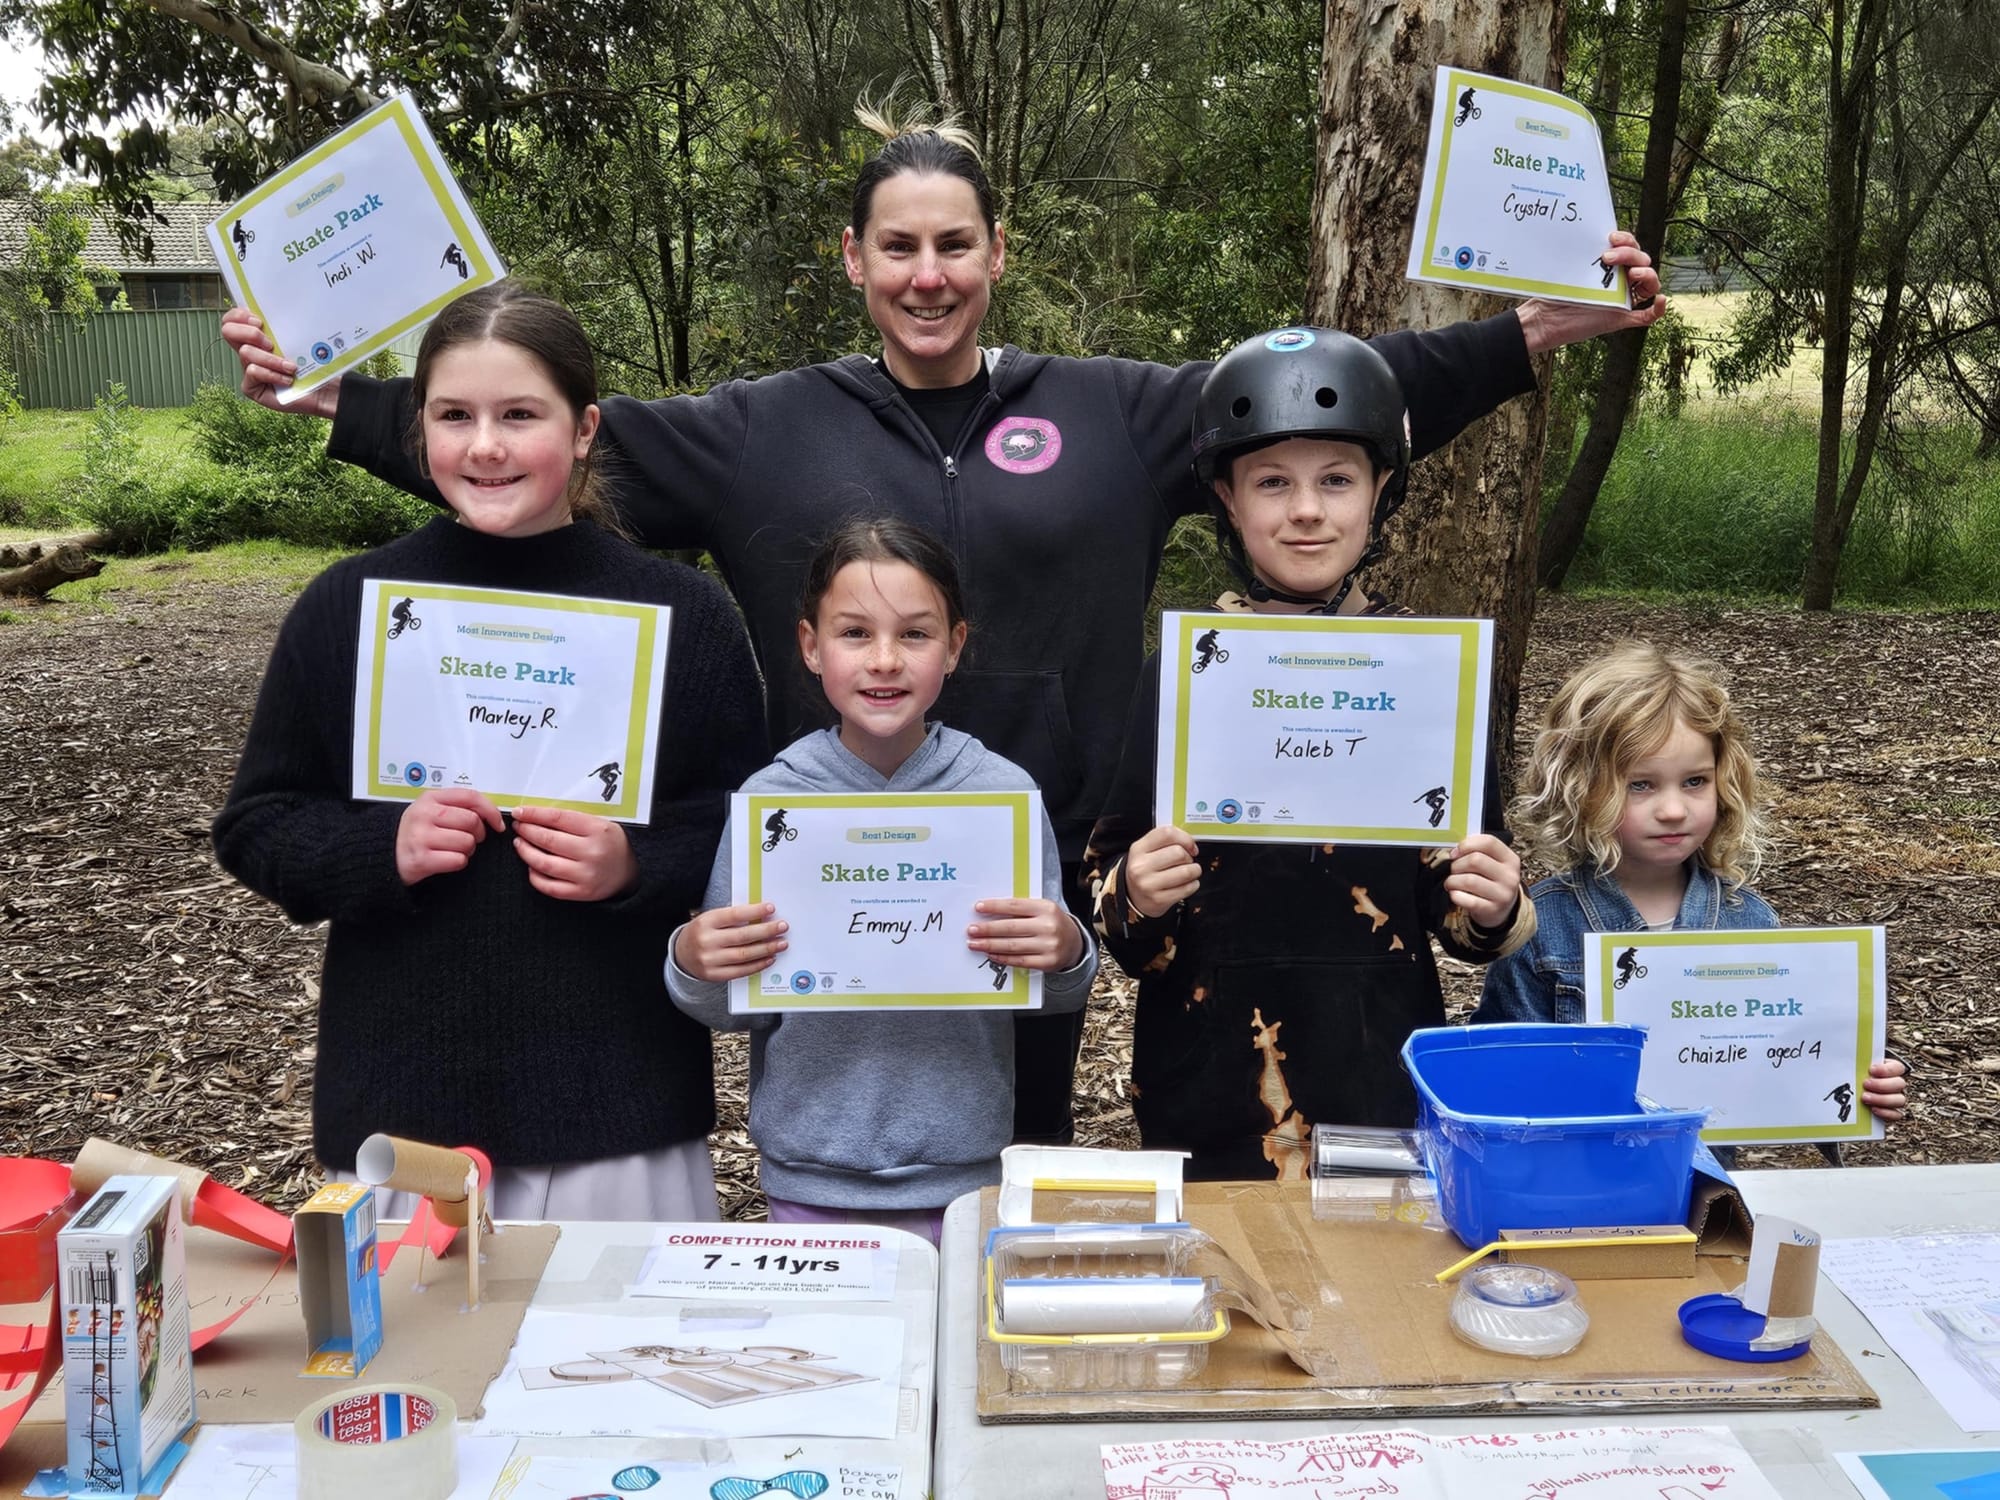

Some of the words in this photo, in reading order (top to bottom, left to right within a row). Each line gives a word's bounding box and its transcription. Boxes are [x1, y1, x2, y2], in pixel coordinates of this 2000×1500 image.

[1493, 147, 1542, 172] Skate
[1546, 156, 1586, 181] Park
[1503, 192, 1559, 222] Crystal
[283, 224, 335, 263] Skate
[333, 194, 384, 231] Park
[457, 625, 479, 635] Most
[481, 626, 531, 639] Innovative
[532, 631, 566, 644] Design
[439, 656, 507, 679] Skate
[514, 662, 576, 686] Park
[1268, 654, 1292, 665] Most
[1294, 656, 1346, 666] Innovative
[1348, 657, 1384, 669] Design
[1251, 689, 1325, 710] Skate
[1331, 690, 1397, 711] Park
[1275, 736, 1334, 759] Kaleb
[1345, 736, 1368, 756] T
[862, 831, 881, 840] Best
[884, 830, 917, 840] Design
[821, 864, 889, 882] Skate
[897, 862, 957, 881] Park
[1683, 968, 1705, 977] Most
[1707, 968, 1755, 976] Innovative
[1757, 967, 1790, 976] Design
[1671, 1000, 1738, 1018] Skate
[1744, 998, 1804, 1017] Park
[1678, 1044, 1748, 1064] Chaizlie
[1767, 1040, 1805, 1068] aged
[1808, 1040, 1822, 1060] 4
[668, 1235, 797, 1247] COMPETITION
[803, 1239, 881, 1249] ENTRIES
[703, 1254, 722, 1270] 7
[753, 1255, 841, 1275] 11yrs
